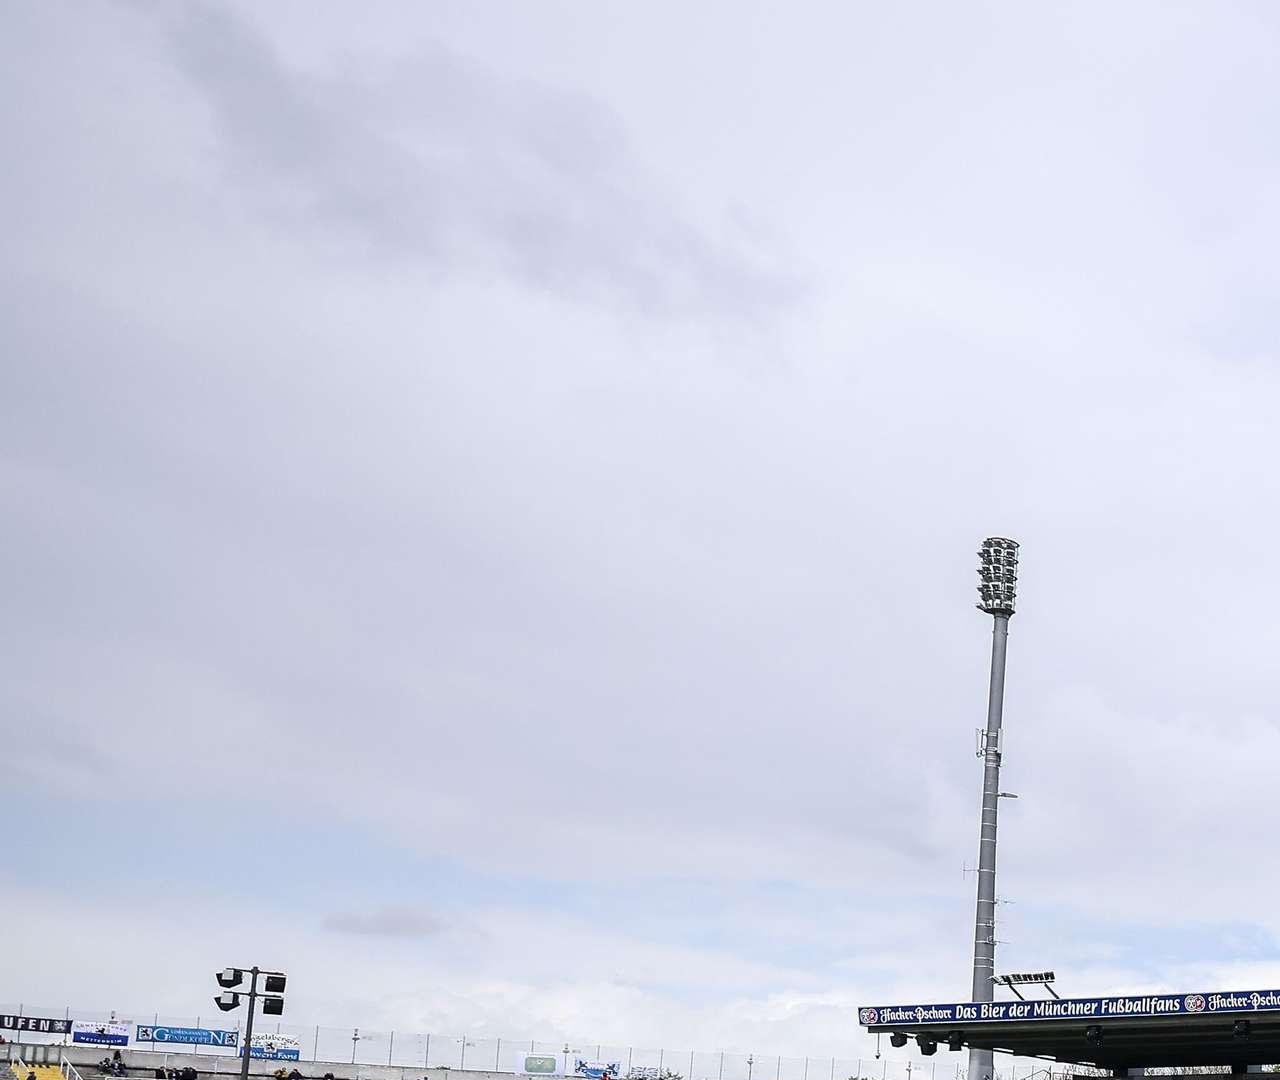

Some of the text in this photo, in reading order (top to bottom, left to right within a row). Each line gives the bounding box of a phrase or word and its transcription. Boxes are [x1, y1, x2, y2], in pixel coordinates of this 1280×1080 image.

[879, 996, 1180, 1023] Hacker-Pschorr Das Bier der Münchner Fußballfans
